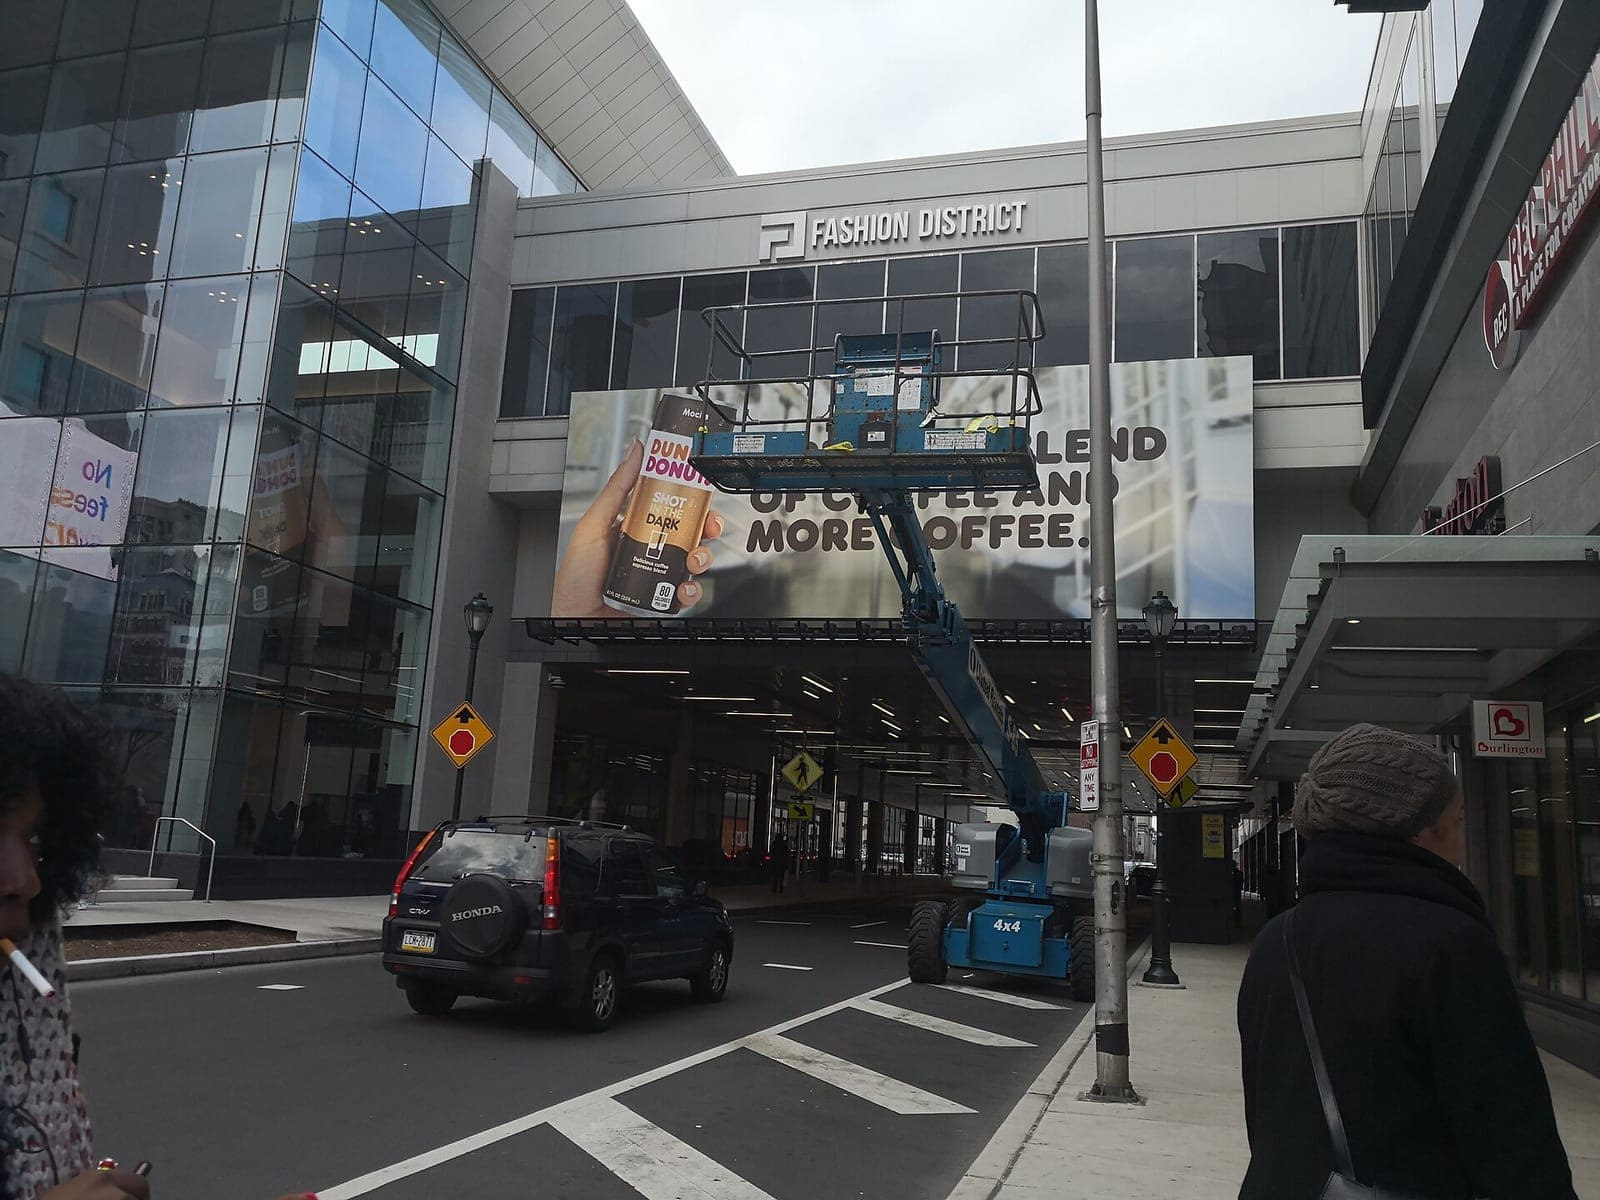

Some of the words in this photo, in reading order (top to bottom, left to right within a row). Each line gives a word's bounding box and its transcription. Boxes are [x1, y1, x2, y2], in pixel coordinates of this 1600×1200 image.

[811, 211, 910, 249] FASHION
[918, 200, 1028, 239] DISTRICT
[1521, 252, 1545, 309] PLACE
[1544, 224, 1561, 268] FOR
[1492, 301, 1509, 350] REC
[650, 438, 691, 462] DUN
[1036, 427, 1167, 465] LEND
[645, 456, 713, 487] DONU
[652, 491, 688, 509] SHOT
[663, 506, 684, 520] THE
[646, 513, 680, 533] DARK
[746, 518, 876, 553] MORE
[889, 513, 1091, 551] OFFEE.
[659, 586, 671, 598] 80
[1477, 742, 1544, 756] Burlington
[1084, 772, 1096, 782] ANY
[1084, 783, 1096, 793] TIME
[451, 904, 503, 922] HONDA
[993, 918, 1022, 933] 4x4
